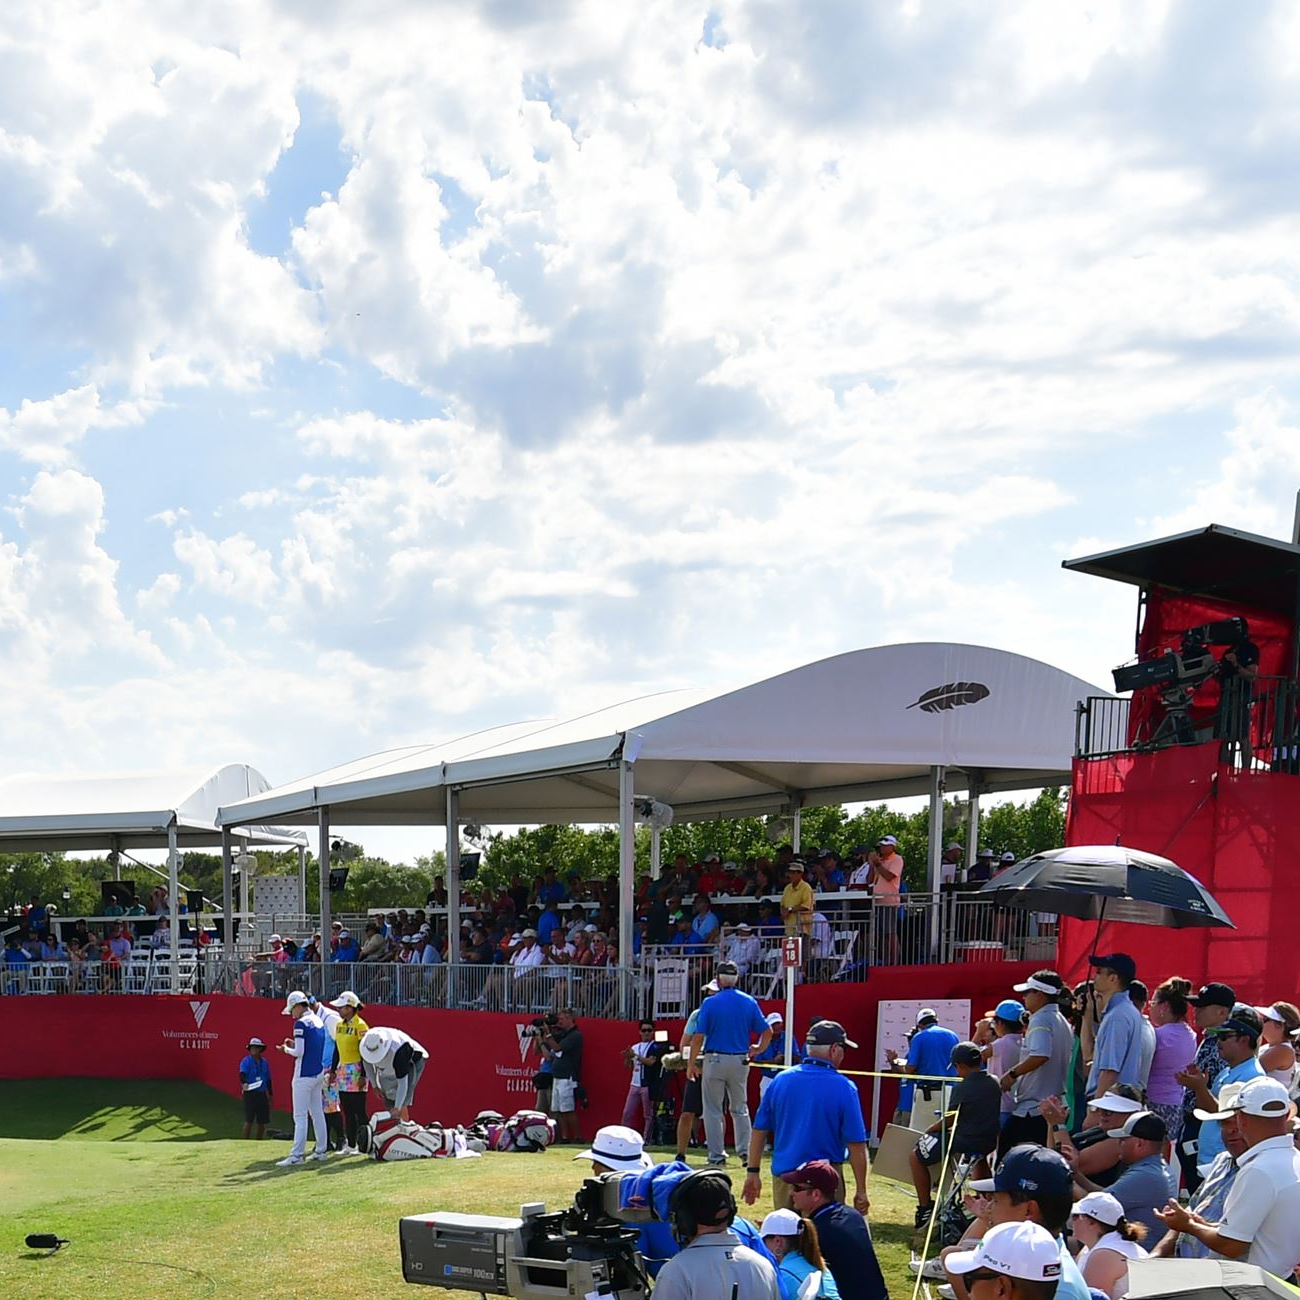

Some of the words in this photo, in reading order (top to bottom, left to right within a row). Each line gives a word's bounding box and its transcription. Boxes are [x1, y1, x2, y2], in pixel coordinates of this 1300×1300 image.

[786, 950, 796, 961] 18
[411, 1262, 423, 1270] HD
[1000, 1262, 1011, 1271] V1
